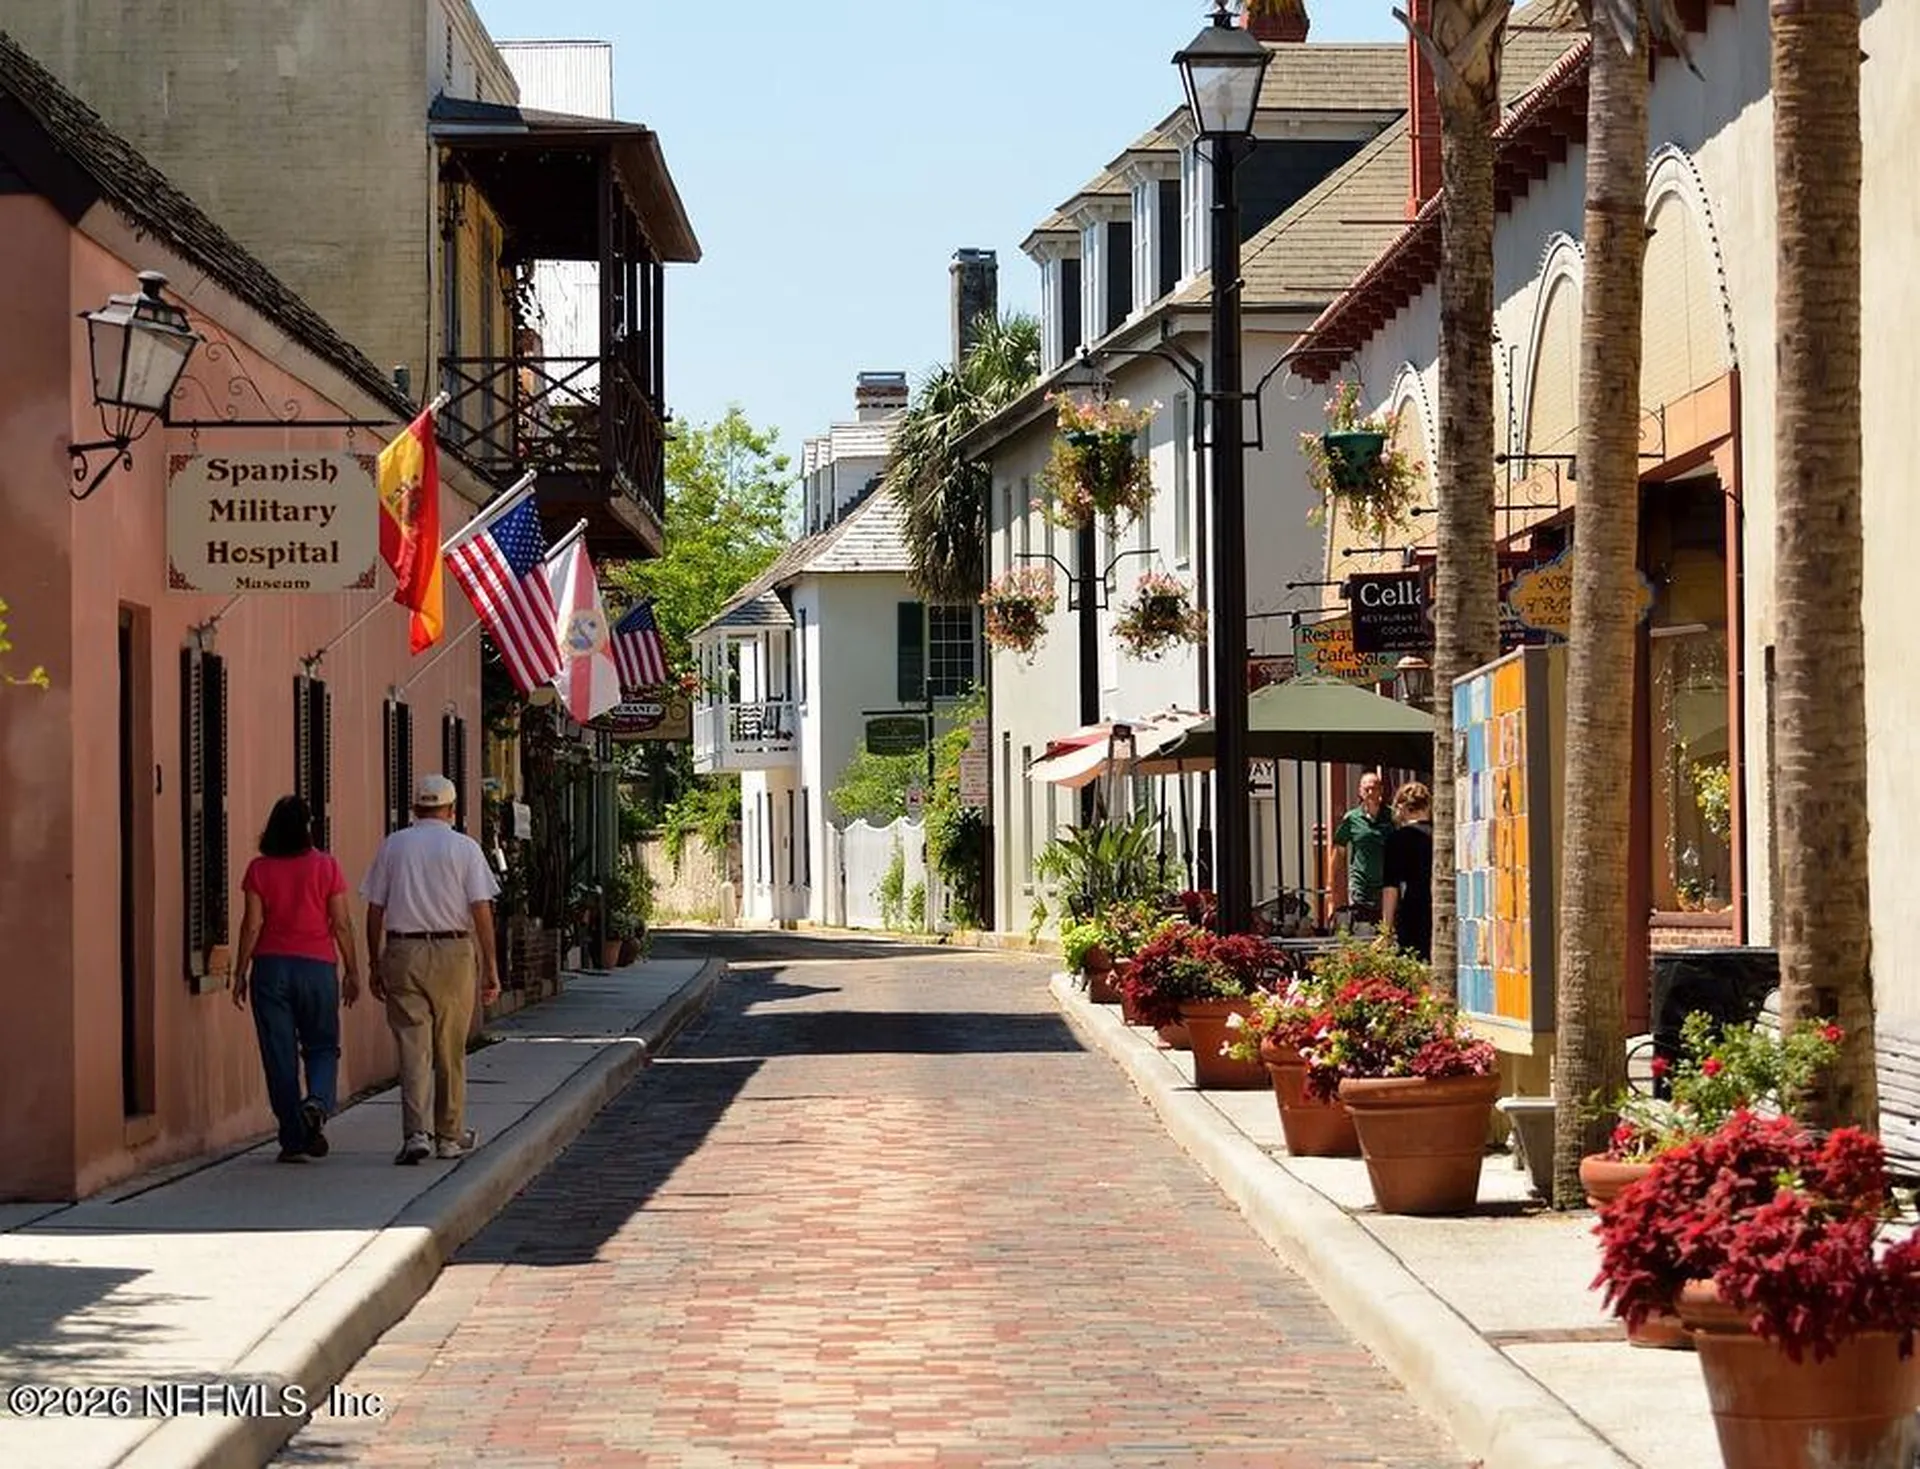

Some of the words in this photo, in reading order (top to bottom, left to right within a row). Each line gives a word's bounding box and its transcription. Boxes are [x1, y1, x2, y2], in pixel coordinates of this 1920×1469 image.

[206, 458, 338, 486] Spanish
[209, 499, 336, 527] Military
[207, 540, 338, 569] Hospital
[1252, 762, 1274, 776] AY
